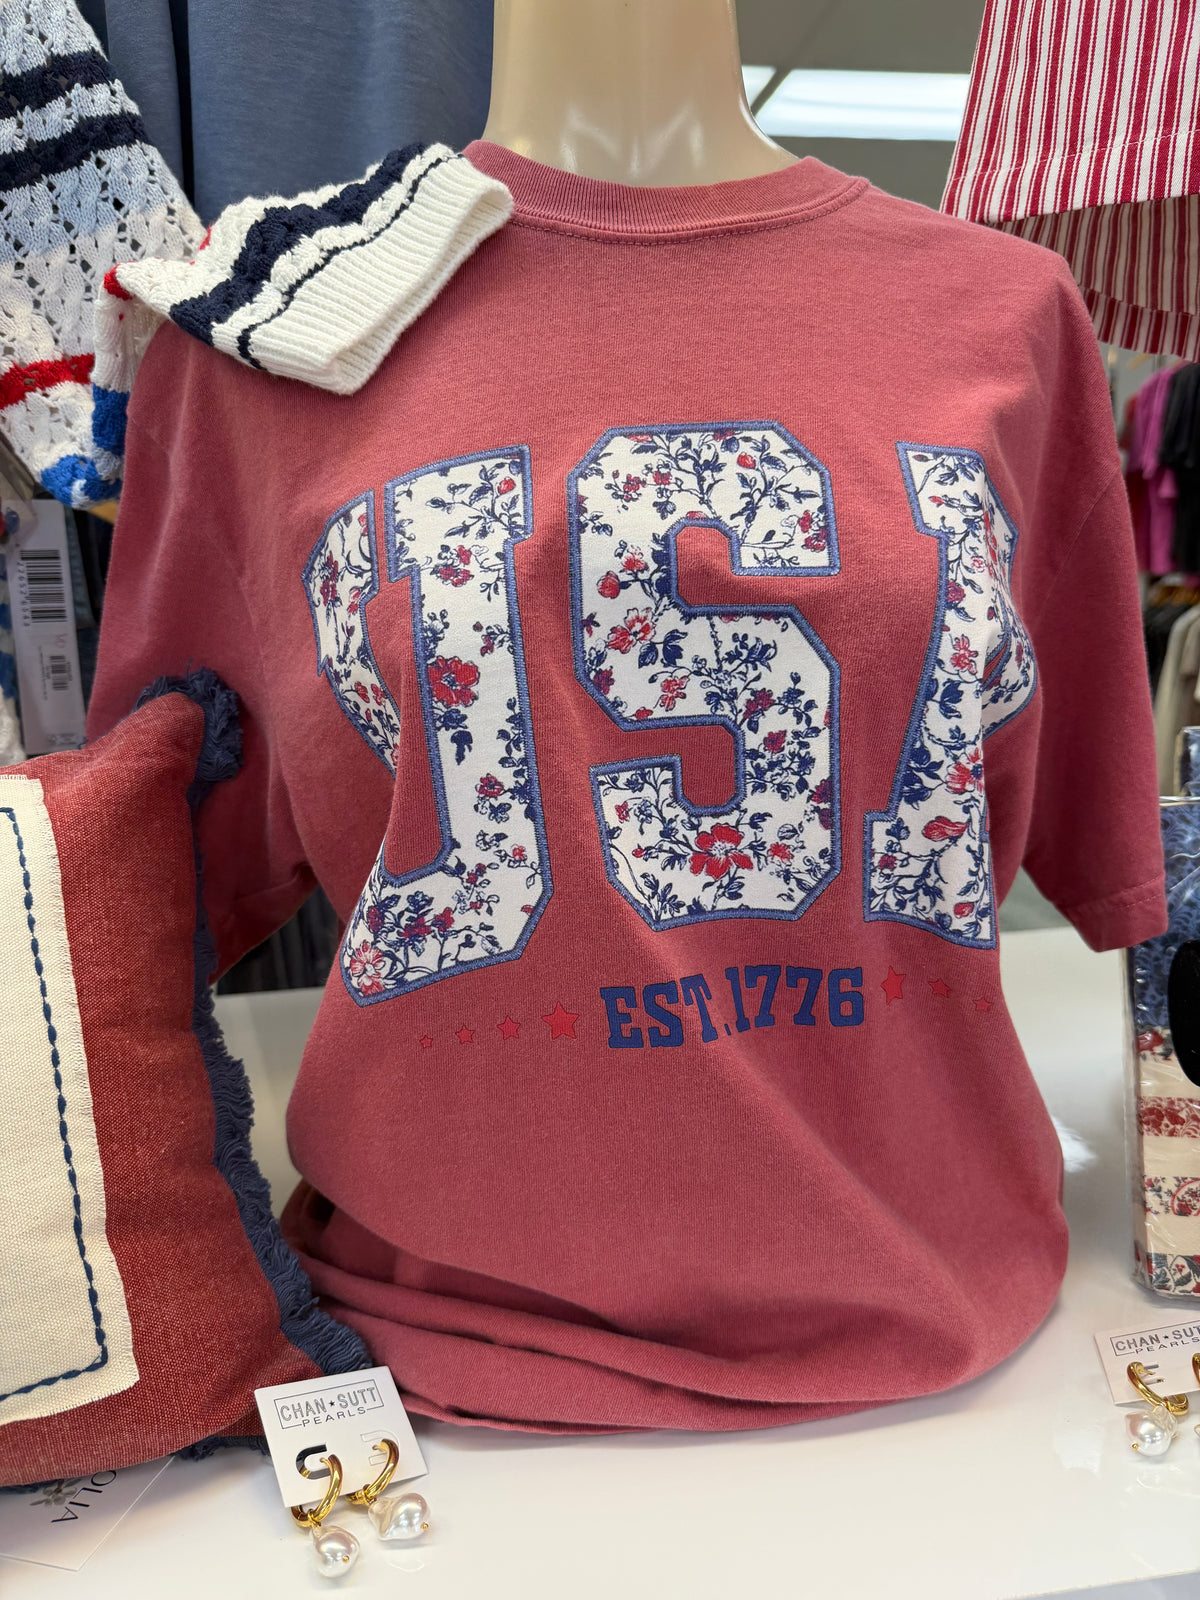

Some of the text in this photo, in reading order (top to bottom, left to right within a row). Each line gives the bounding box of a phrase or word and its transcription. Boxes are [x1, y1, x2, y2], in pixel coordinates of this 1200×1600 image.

[725, 964, 864, 1034] 1776
[1115, 1334, 1161, 1351] CHAN
[1135, 1337, 1200, 1354] PEARLS
[280, 1387, 377, 1421] CHAN SUTT
[302, 1407, 366, 1427] PEARLS
